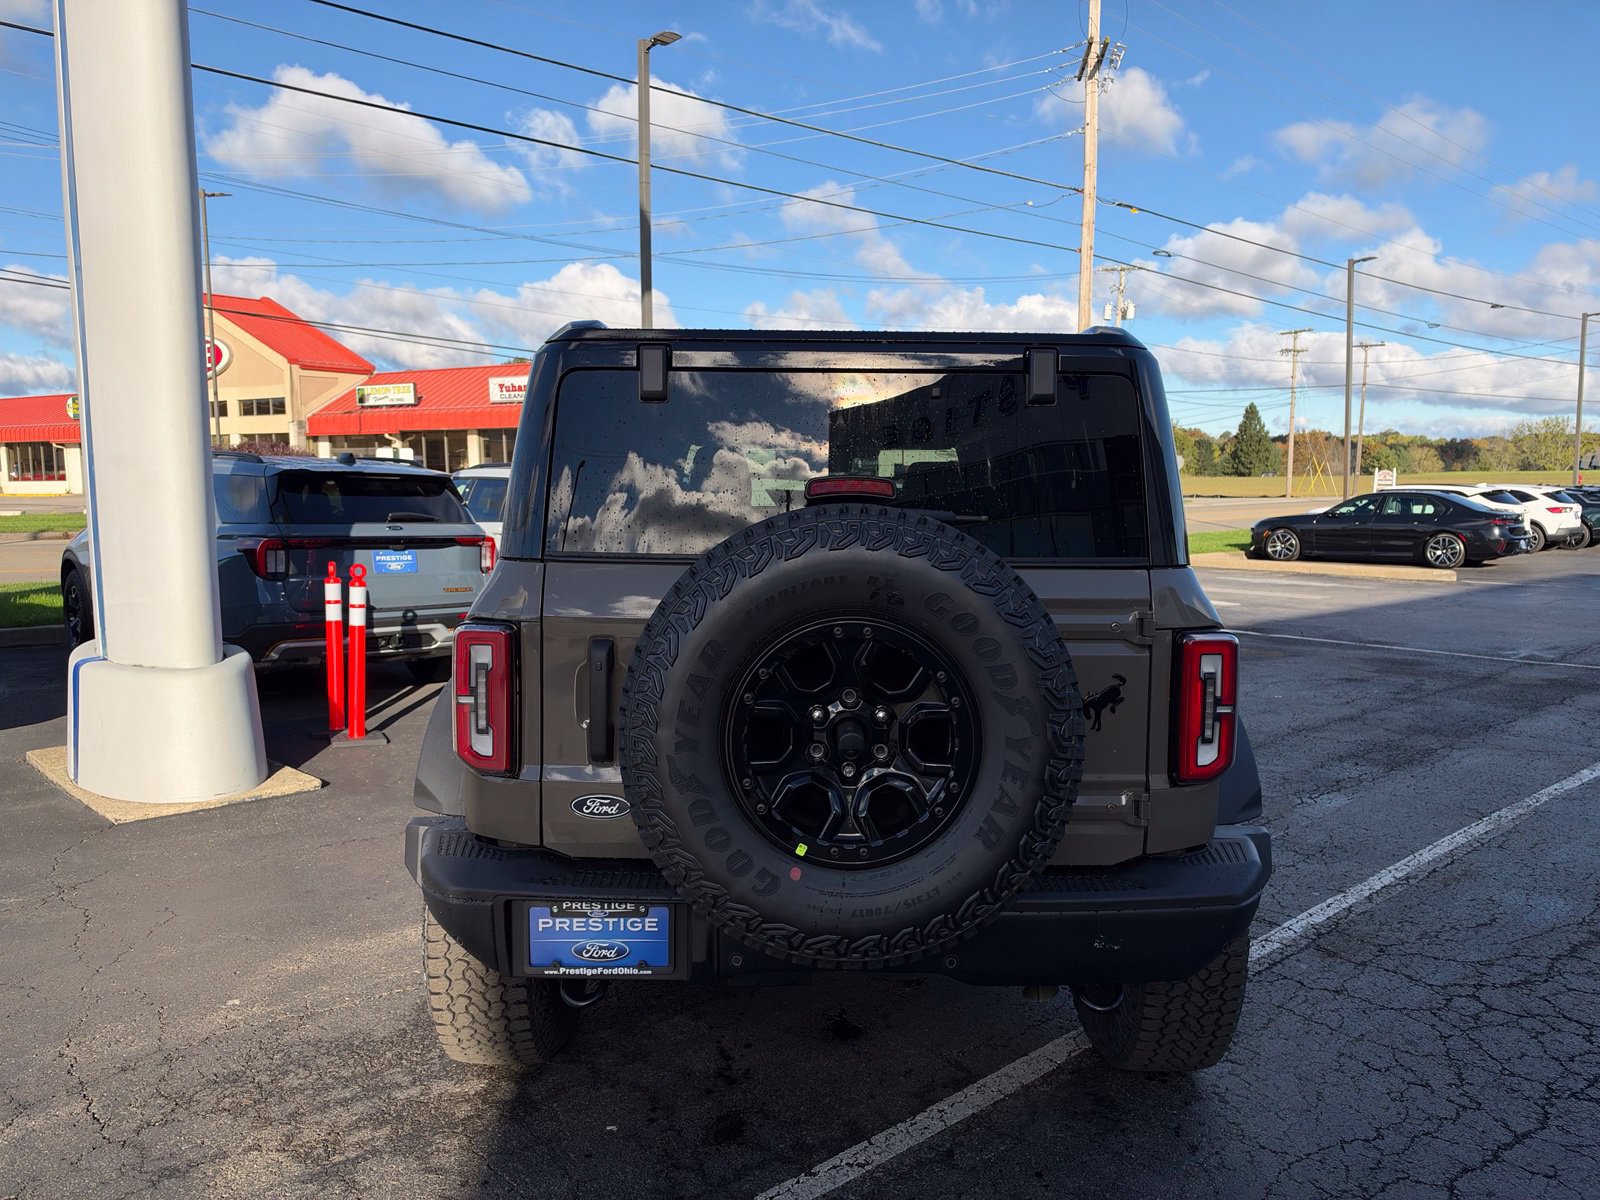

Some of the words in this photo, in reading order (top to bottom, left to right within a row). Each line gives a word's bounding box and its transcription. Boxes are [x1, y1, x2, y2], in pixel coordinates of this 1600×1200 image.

[365, 386, 390, 395] LEMON
[392, 385, 411, 394] TREE
[583, 798, 619, 814] Ford
[562, 901, 635, 910] PRESTIGE
[538, 918, 658, 931] PRESTIGE
[582, 942, 617, 958] Ford
[544, 967, 652, 976] www.PrestigeFordOhio.com
